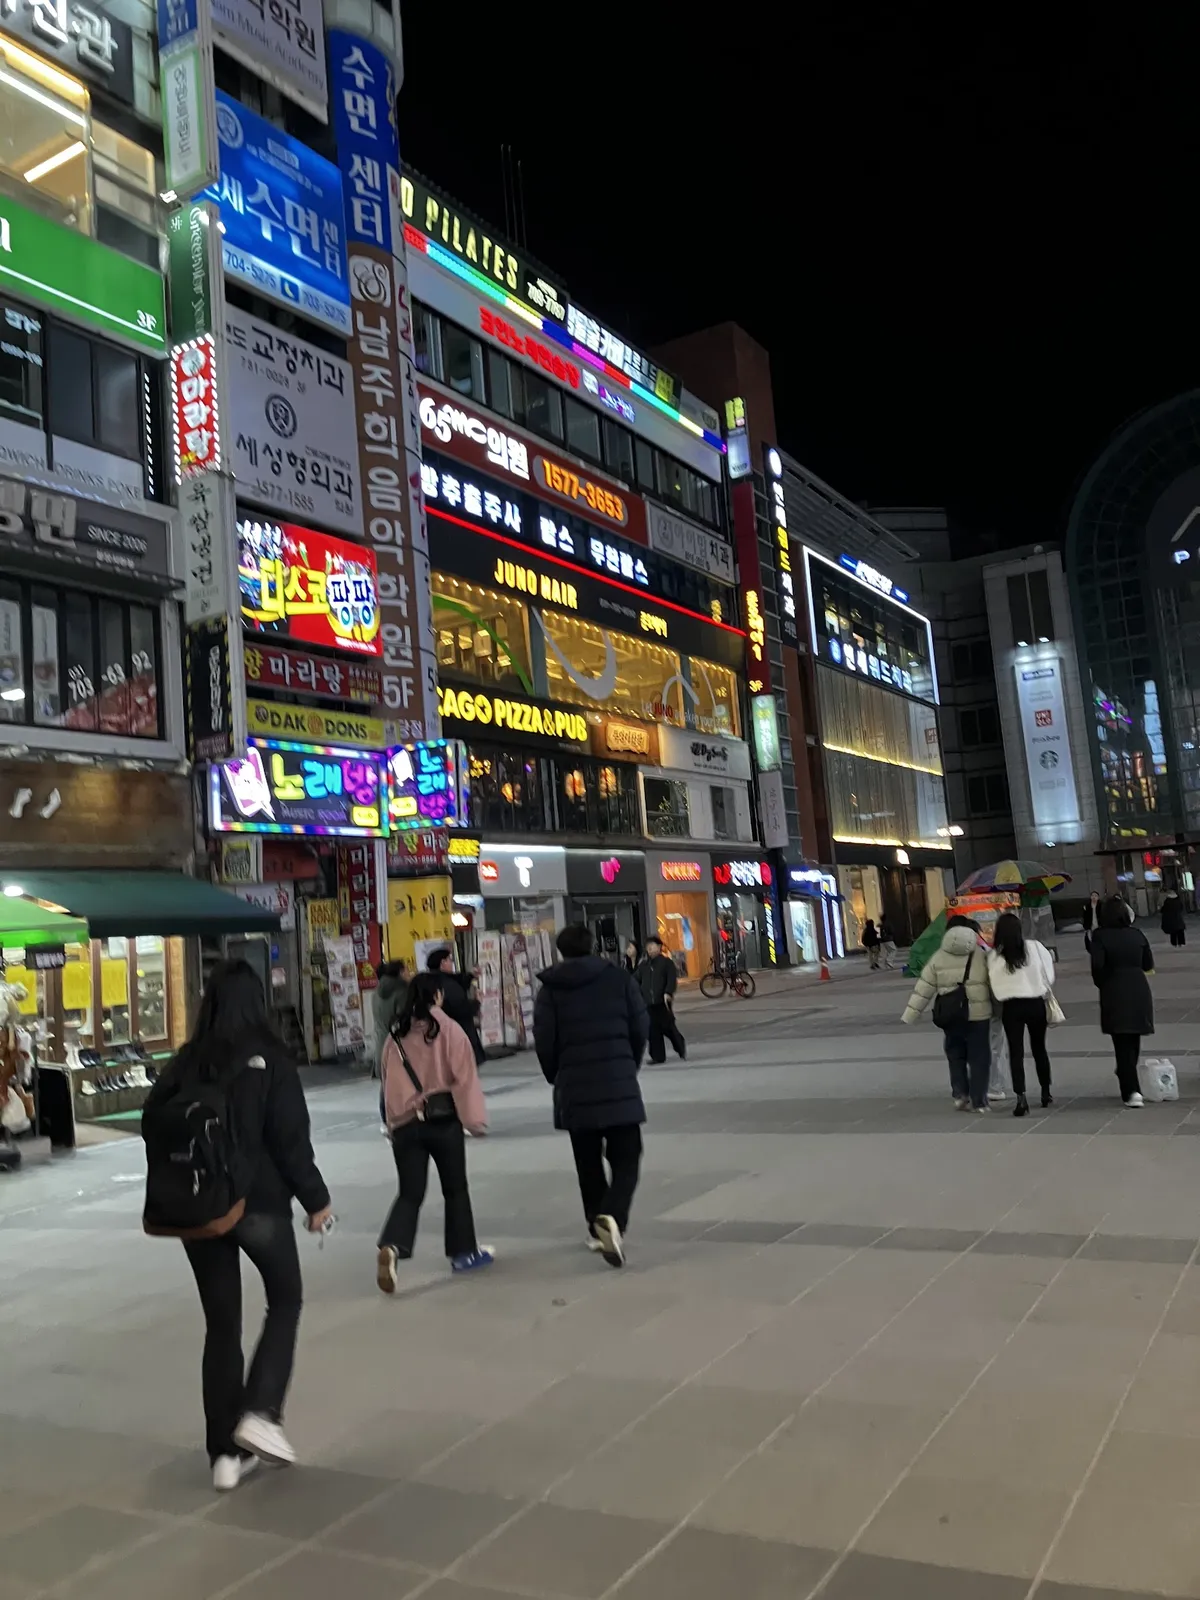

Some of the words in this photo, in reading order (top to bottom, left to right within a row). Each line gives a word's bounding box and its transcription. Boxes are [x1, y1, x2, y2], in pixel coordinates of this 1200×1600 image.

[342, 46, 375, 140] 수면
[348, 154, 384, 244] 센터
[425, 196, 518, 290] PILATES
[137, 309, 158, 331] 3F
[180, 374, 211, 460] 마라탕
[541, 457, 625, 521] 1577-3653
[87, 524, 122, 548] SINCE
[259, 557, 331, 620] 디스코
[494, 558, 538, 596] JUNO
[541, 577, 579, 610] HAIR
[268, 653, 344, 694] 마라탕
[383, 675, 414, 709] 5F
[269, 709, 306, 731] DAK
[324, 718, 368, 741] DONS
[494, 698, 588, 742] PIZZA&PUB
[271, 752, 379, 805] 노래방
[416, 749, 449, 820] 노래방
